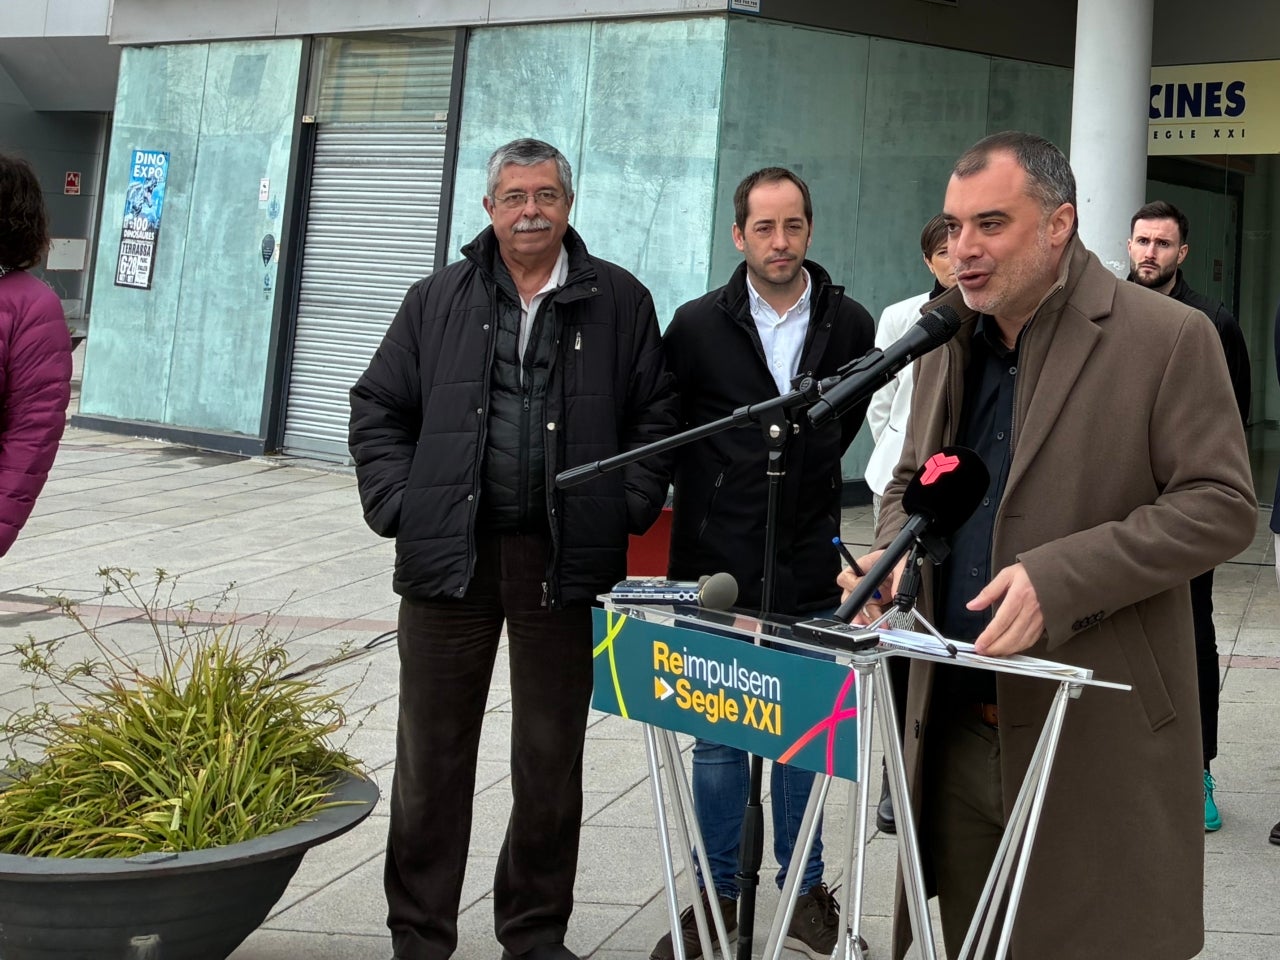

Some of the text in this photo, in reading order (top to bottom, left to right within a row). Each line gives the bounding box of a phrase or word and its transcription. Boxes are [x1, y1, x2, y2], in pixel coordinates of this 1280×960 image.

[1149, 80, 1246, 119] CINES
[1153, 128, 1246, 140] EGLE XXI
[135, 151, 166, 166] DINO
[133, 164, 163, 179] EXPO
[133, 217, 148, 231] 100
[121, 242, 151, 257] TERRASSA
[653, 640, 781, 701] Reimpulsem
[675, 678, 782, 736] Segle XXI
